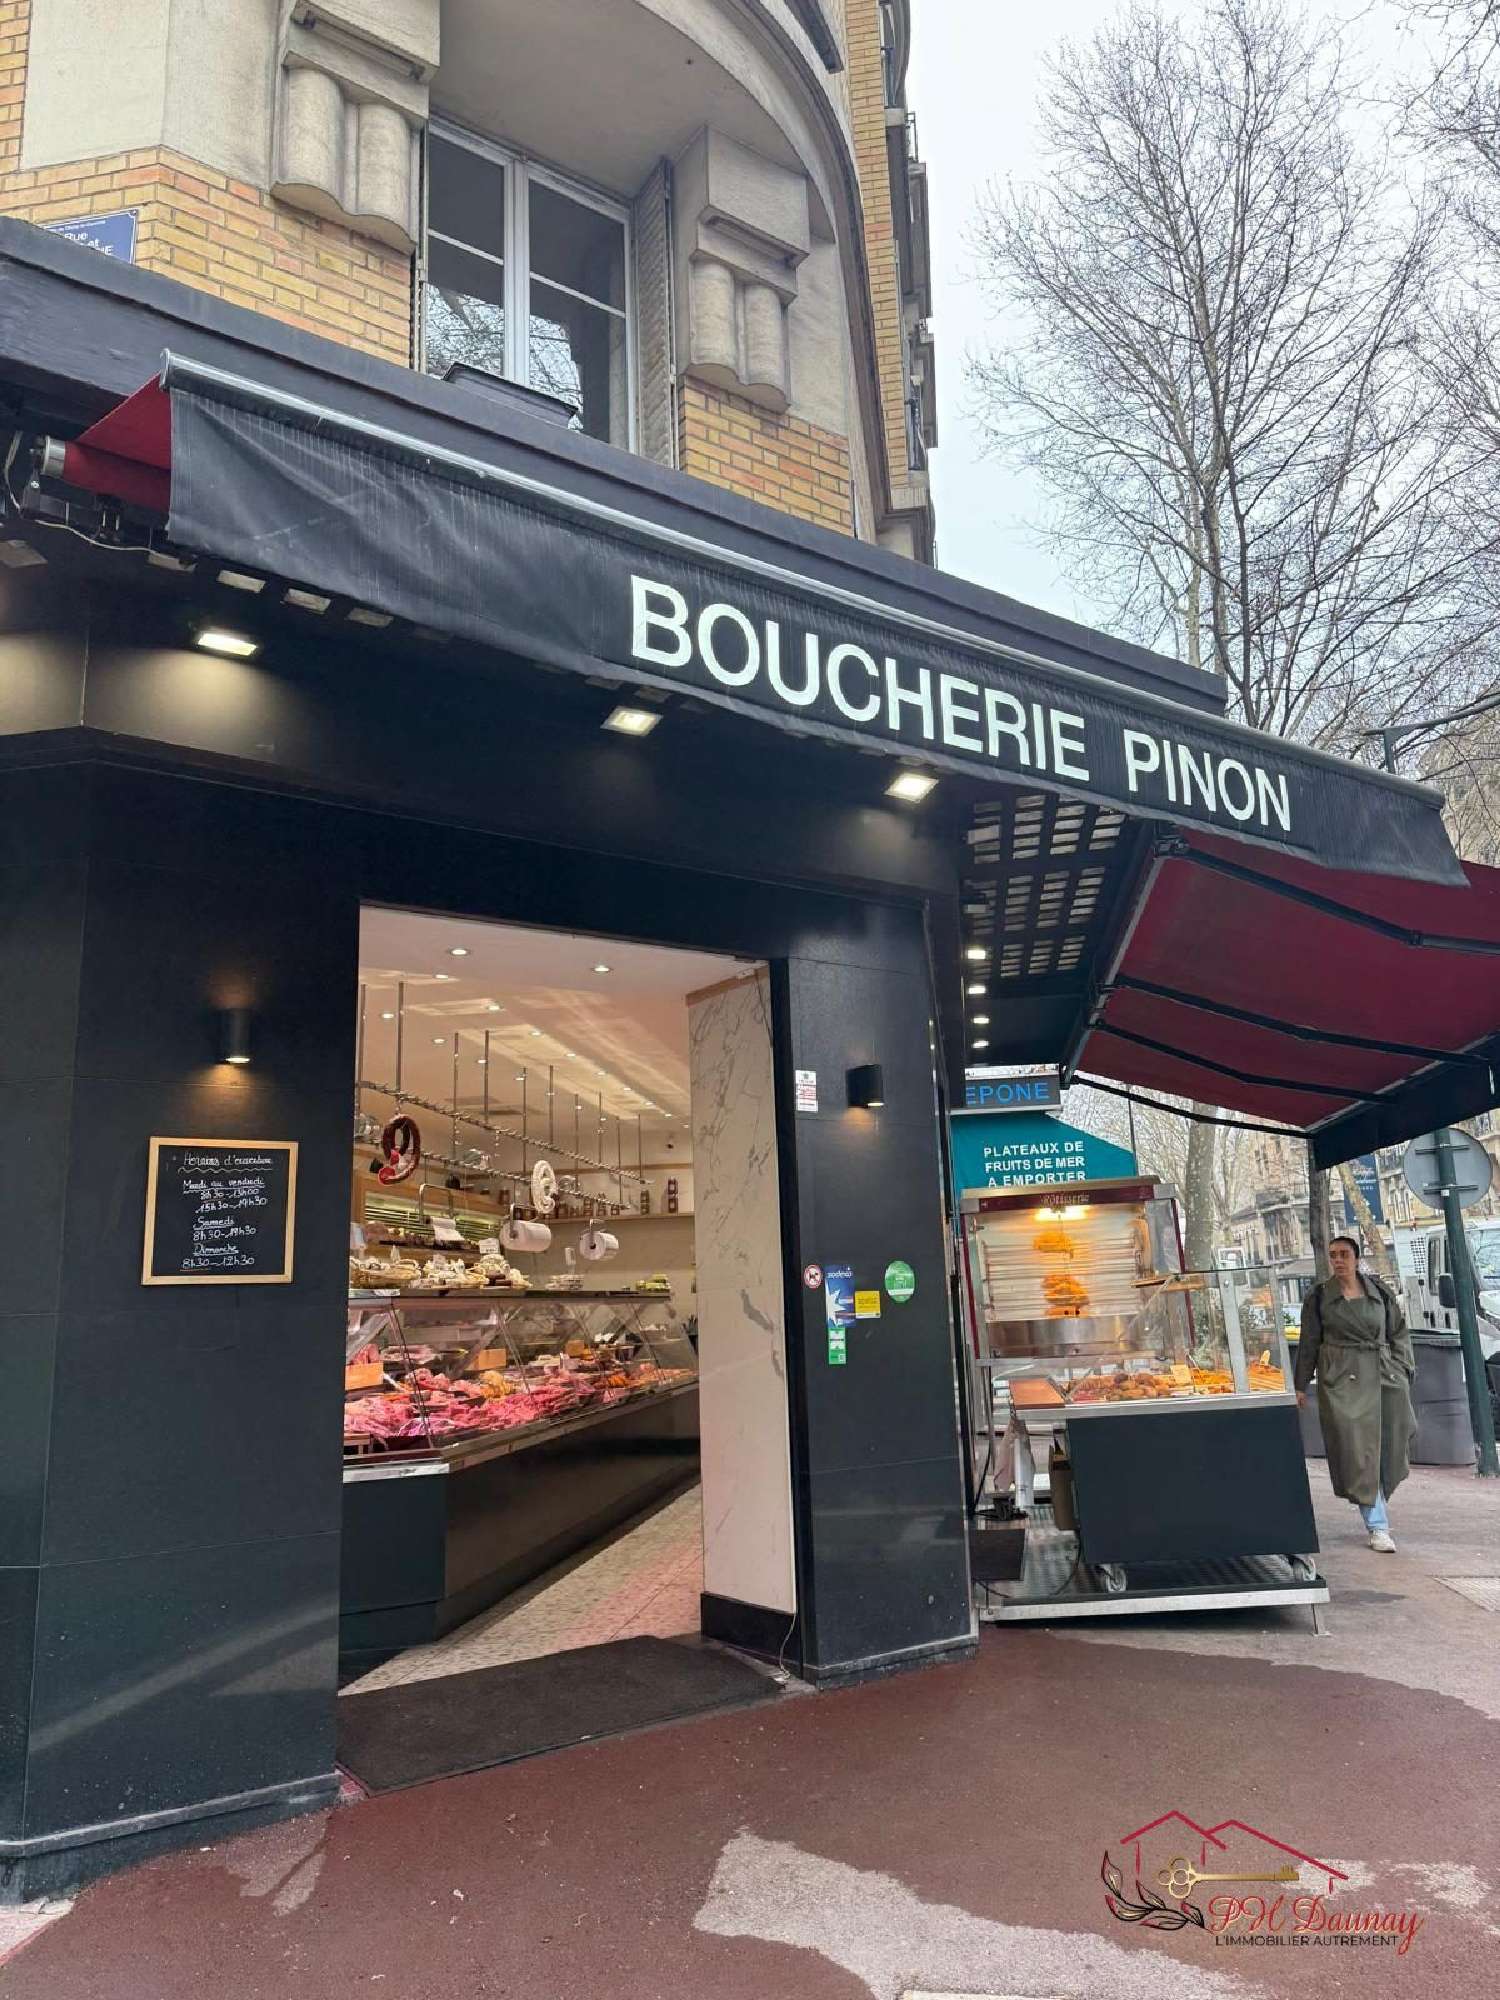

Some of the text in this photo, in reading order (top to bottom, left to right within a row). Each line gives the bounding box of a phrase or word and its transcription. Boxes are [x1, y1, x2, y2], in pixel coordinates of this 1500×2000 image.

[630, 575, 1292, 832] BOUCHERIE PINON
[984, 1141, 1085, 1158] PLATEAUX DE
[985, 1156, 1085, 1173] FRUITS DE MER
[1003, 1171, 1086, 1187] EMPORTER
[197, 1215, 235, 1226] Samedi
